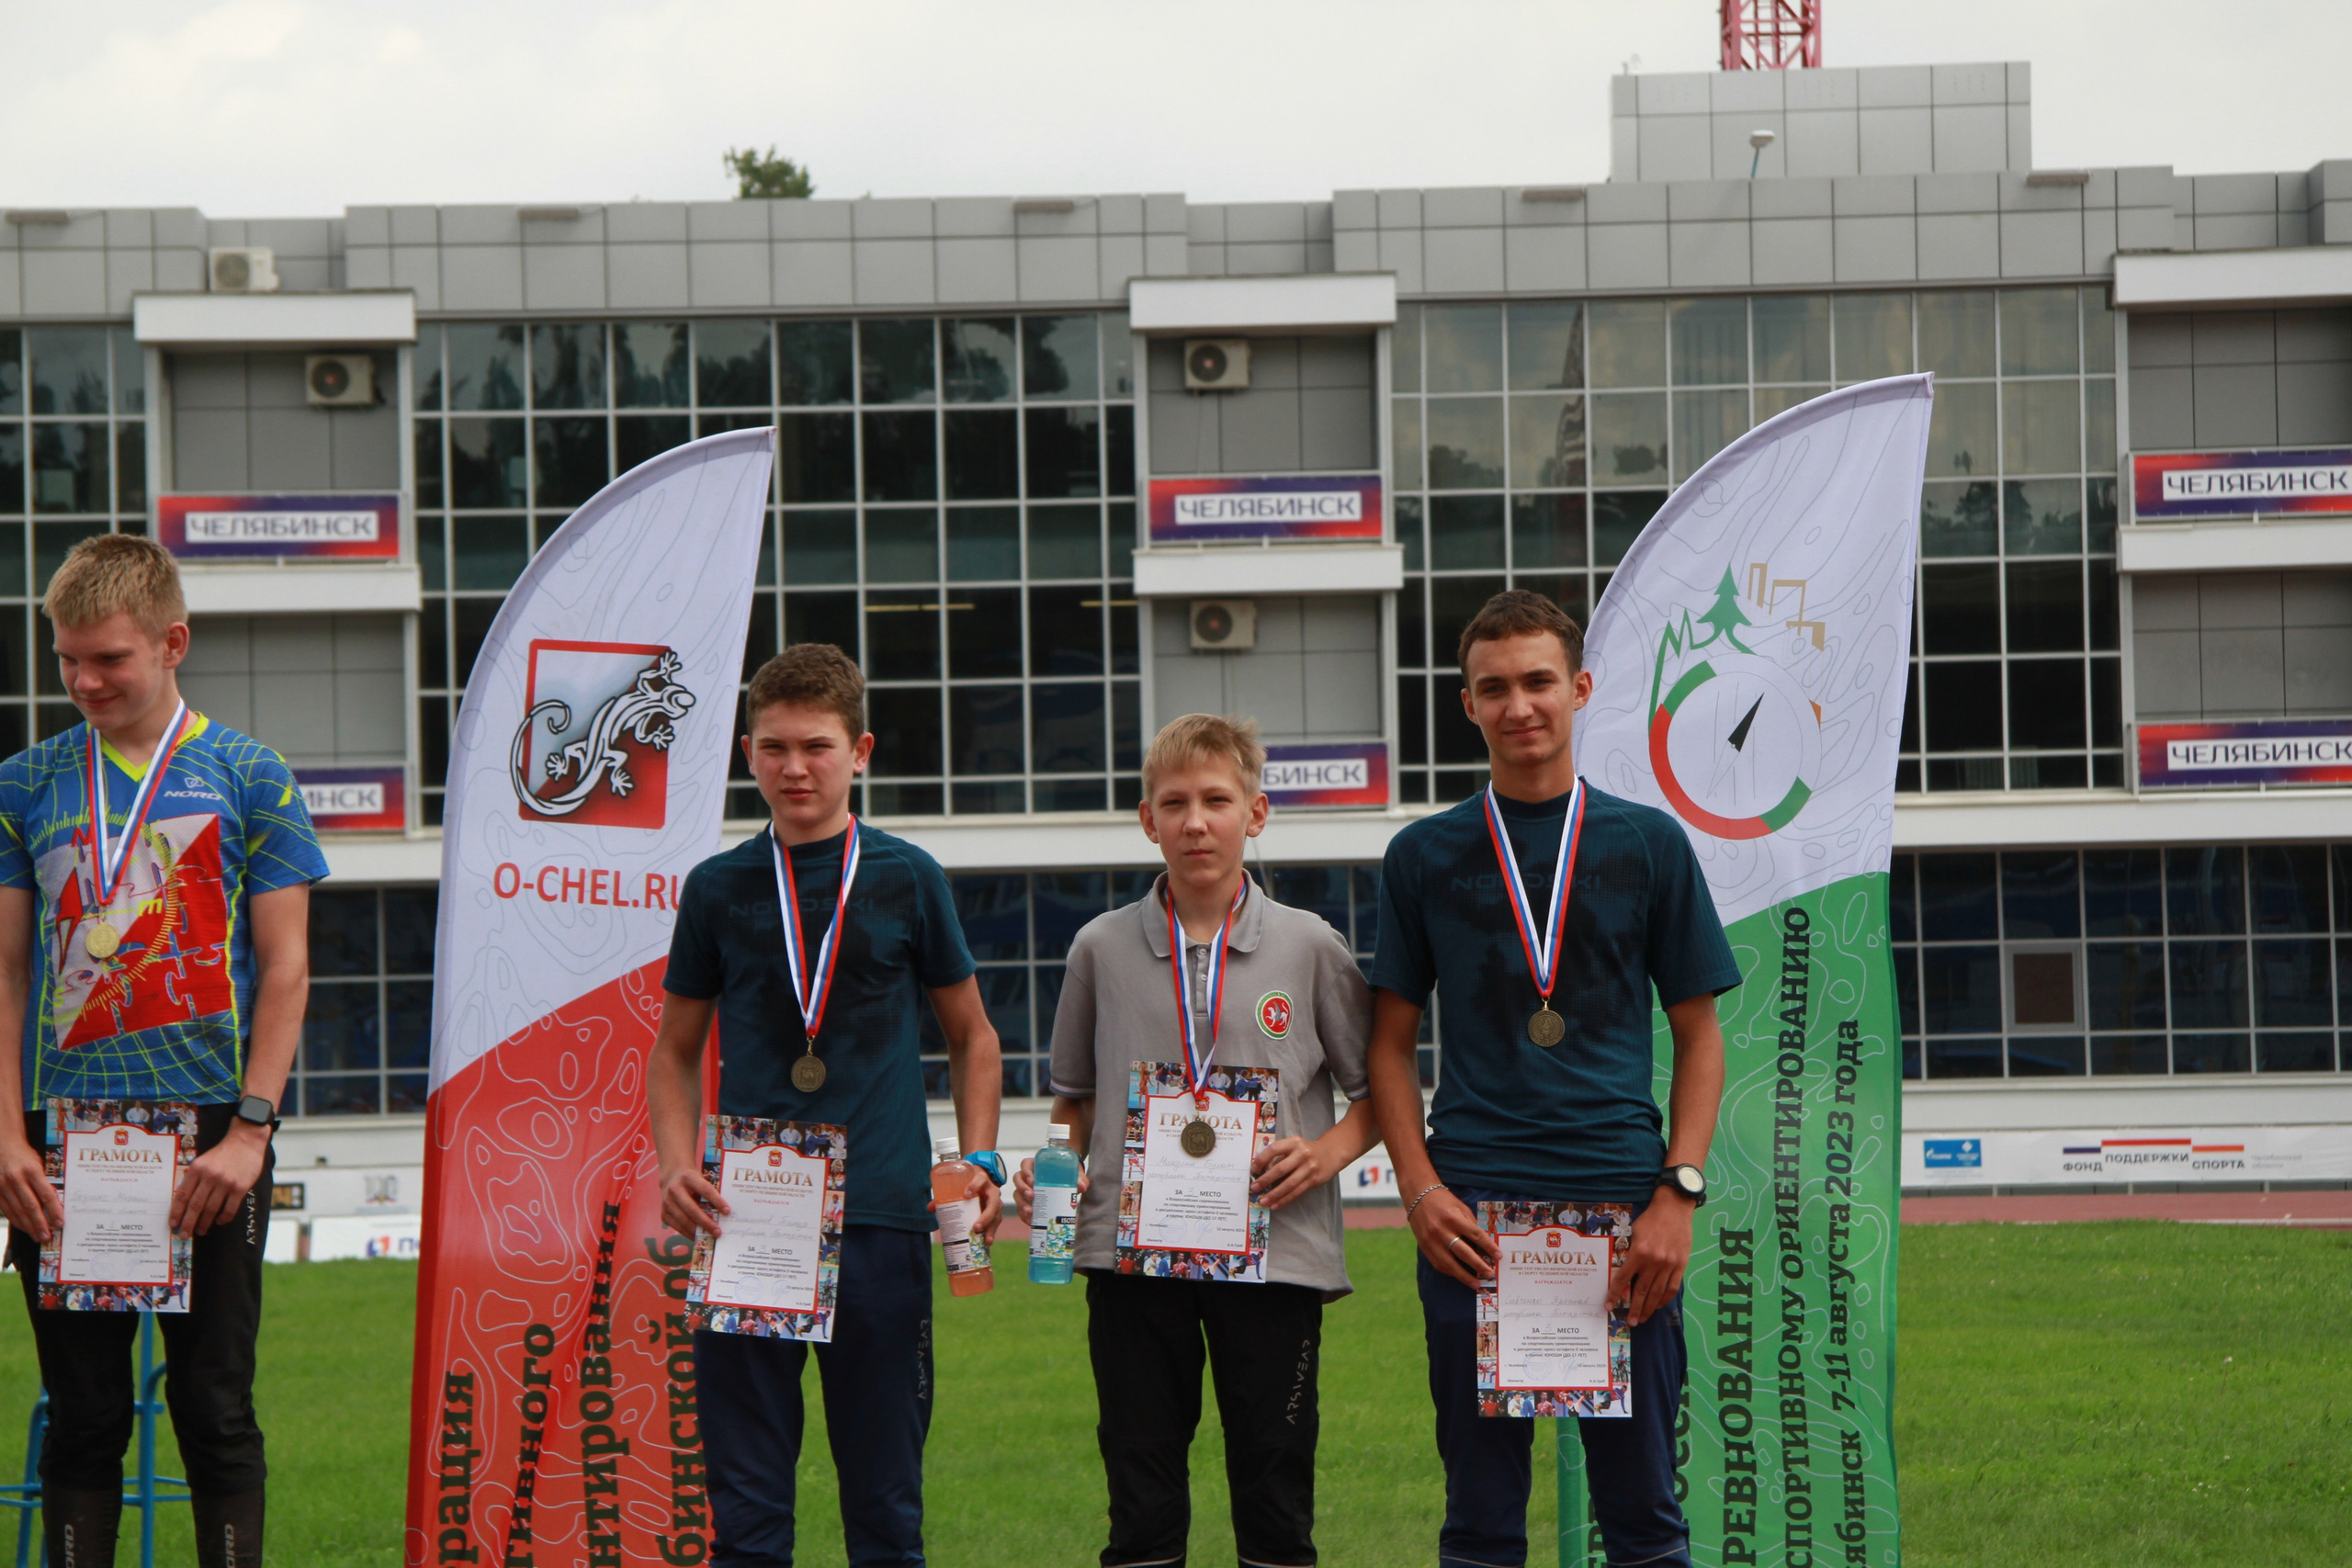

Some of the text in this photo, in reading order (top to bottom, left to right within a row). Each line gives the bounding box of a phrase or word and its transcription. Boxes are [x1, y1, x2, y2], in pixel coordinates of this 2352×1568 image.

[2166, 470, 2348, 494] ЧЕЛЯБИНСК
[1181, 496, 1355, 518] ЧЕЛЯБИНСК
[189, 517, 372, 538] ЧЕЛЯБИНСК
[2172, 741, 2352, 763] ЧЕЛЯБИНСК
[164, 790, 221, 800] NORD
[1835, 1020, 1863, 1105] года
[78, 1147, 164, 1163] ГРАМОТА
[1826, 1111, 1855, 1196] 2023
[2063, 1153, 2245, 1172] ФОНД ПОДДЕРЖКИ СПОРТА
[733, 1167, 813, 1187] ГРАМОТА
[1774, 908, 1813, 1568] СПОРТИВНОМУ ОРИЕНТИРОВАНИЮ
[1510, 1250, 1597, 1266] ГРАМОТА
[1828, 1203, 1855, 1346] августа
[1824, 1353, 1855, 1411] 7-11
[1717, 1227, 1757, 1566] РЕВНОВАНИЯ
